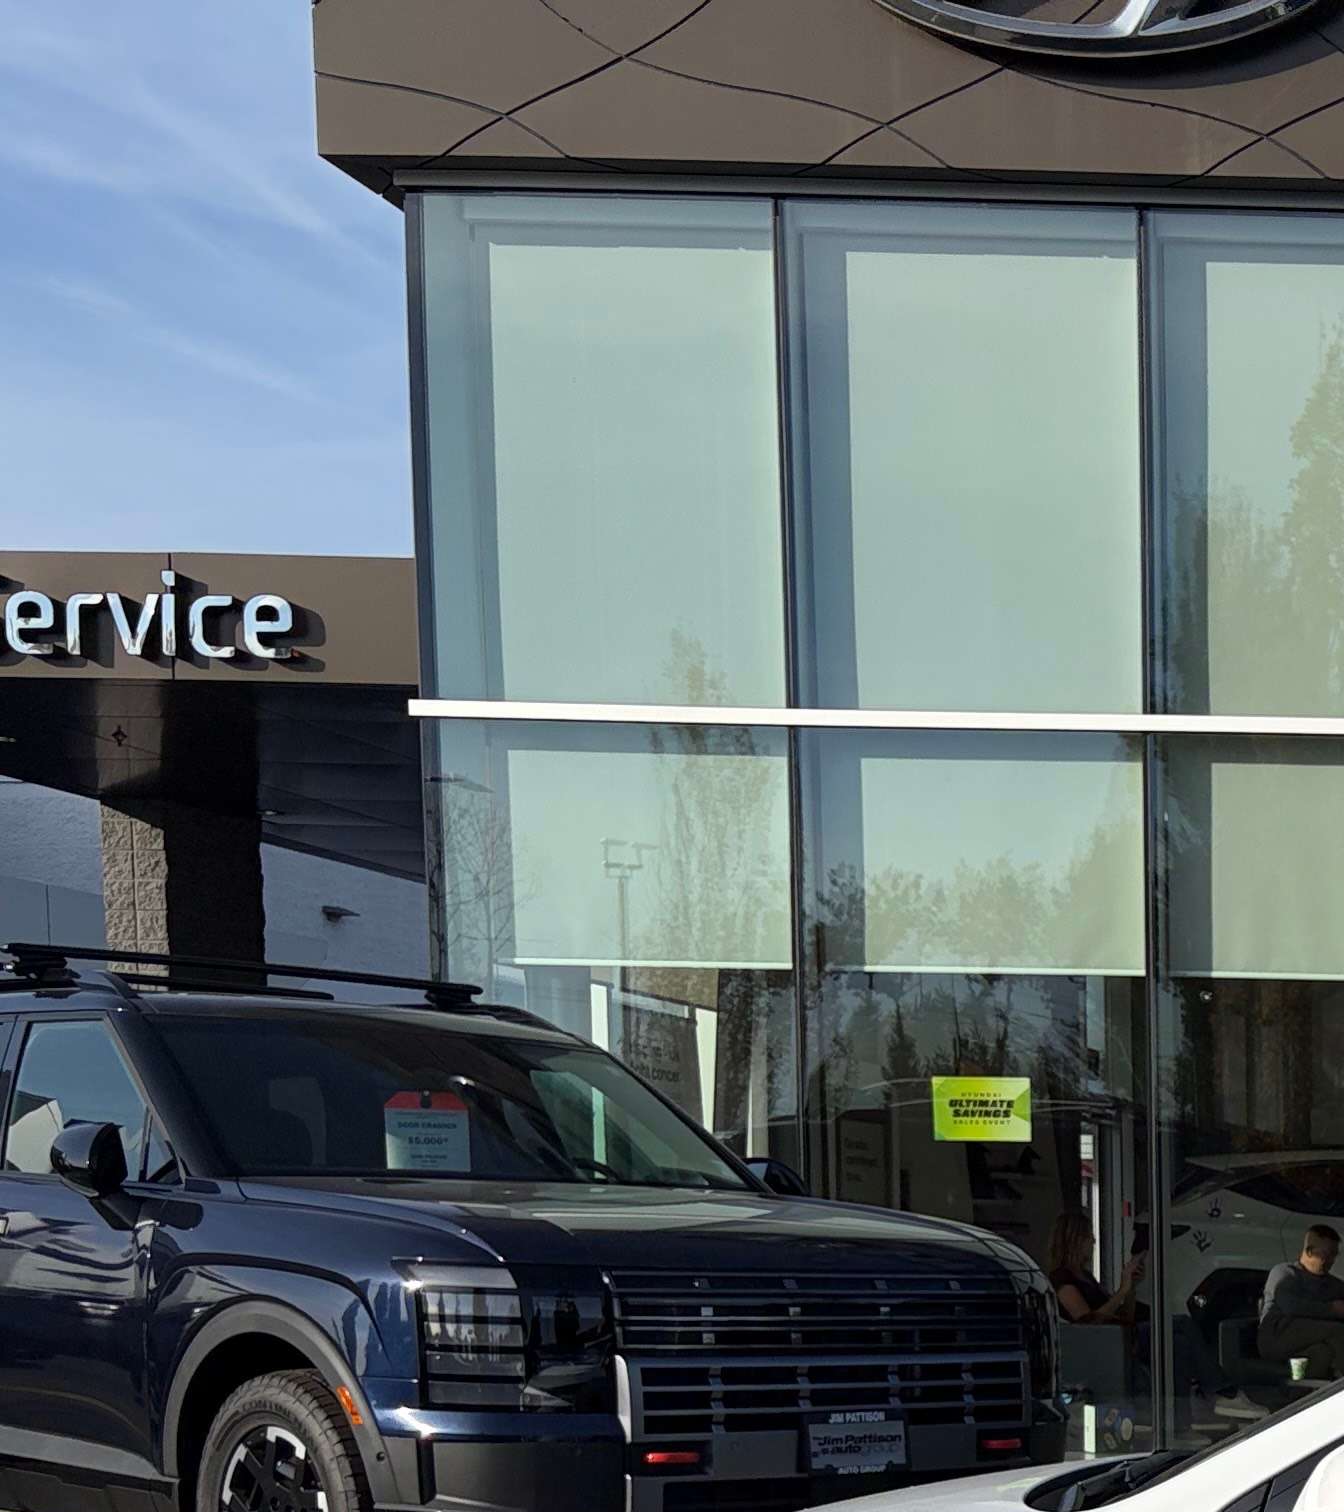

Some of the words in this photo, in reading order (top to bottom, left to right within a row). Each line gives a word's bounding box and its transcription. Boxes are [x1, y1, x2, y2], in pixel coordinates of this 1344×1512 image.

[948, 1099, 1015, 1108] ULTIMATE
[952, 1109, 1011, 1118] SAVINGS
[844, 1433, 902, 1445] Pattison
